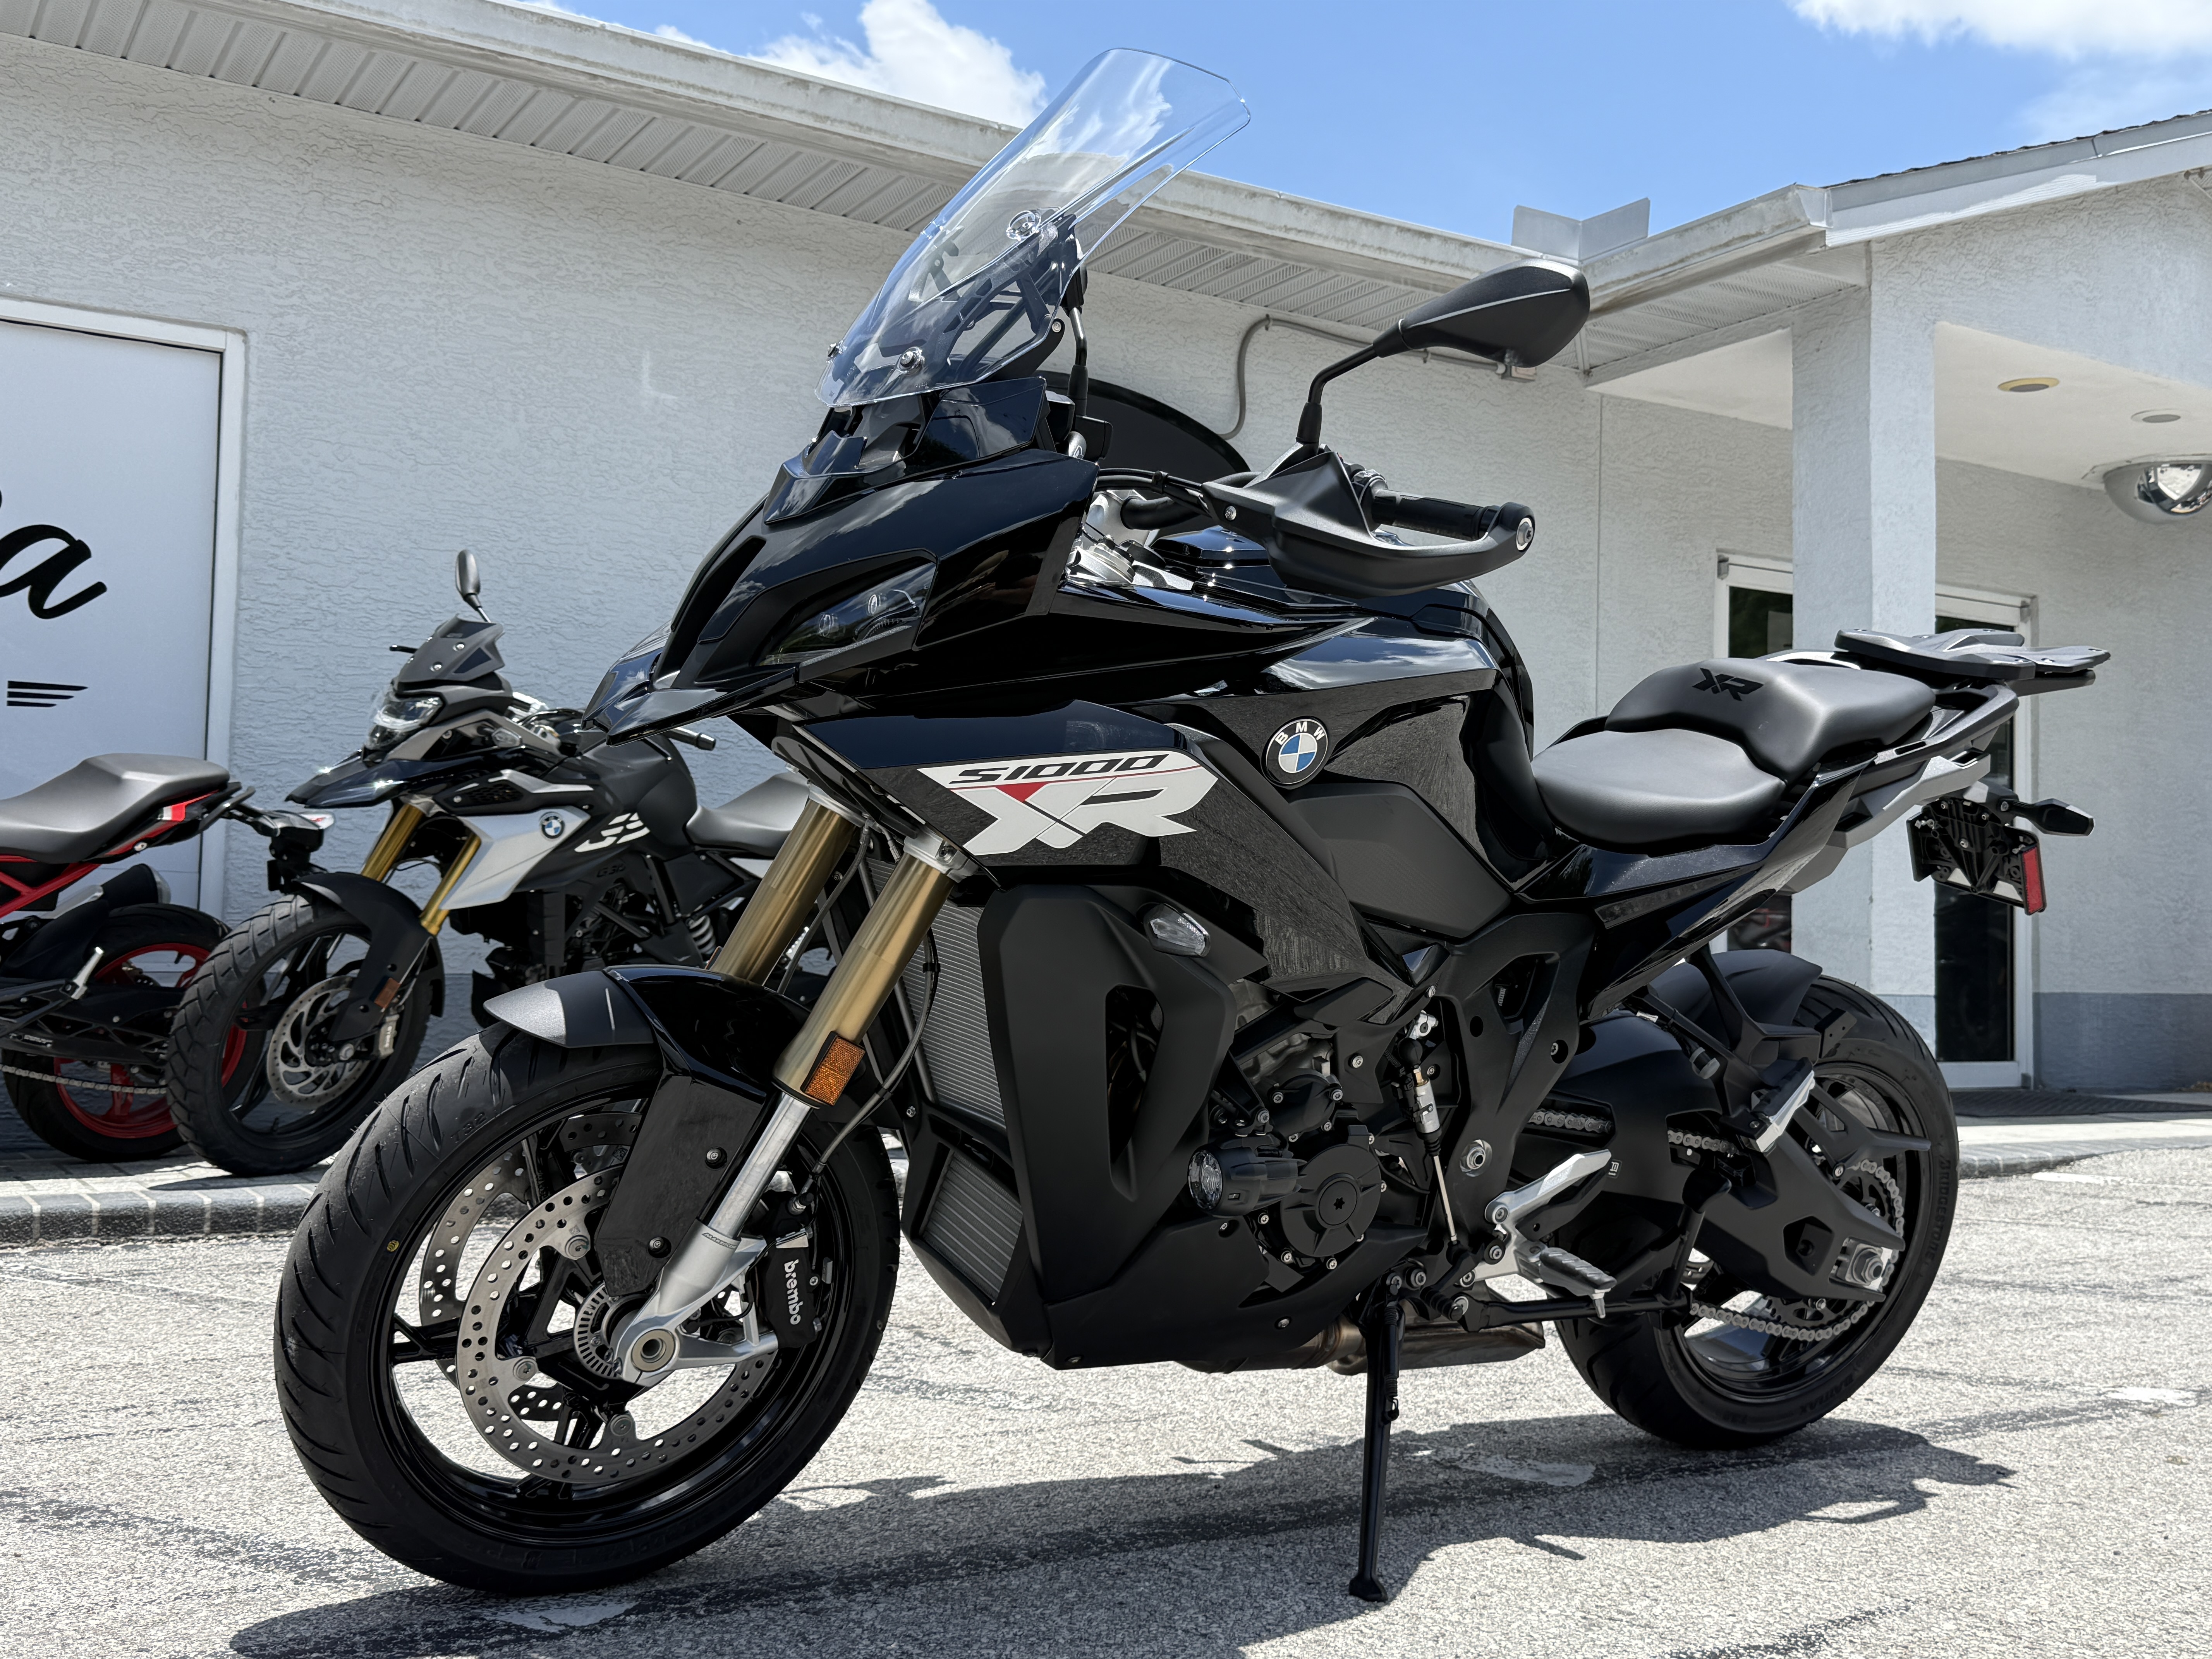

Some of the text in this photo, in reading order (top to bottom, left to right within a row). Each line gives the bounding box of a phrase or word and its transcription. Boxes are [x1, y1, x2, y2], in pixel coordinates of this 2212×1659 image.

[0, 489, 107, 620] a
[1692, 668, 1764, 701] XR
[1275, 721, 1325, 745] BMW
[950, 754, 1169, 785] S1000
[951, 766, 1218, 855] XR
[1925, 1155, 1951, 1261] BRIDGESTONE
[784, 1259, 803, 1325] brembo
